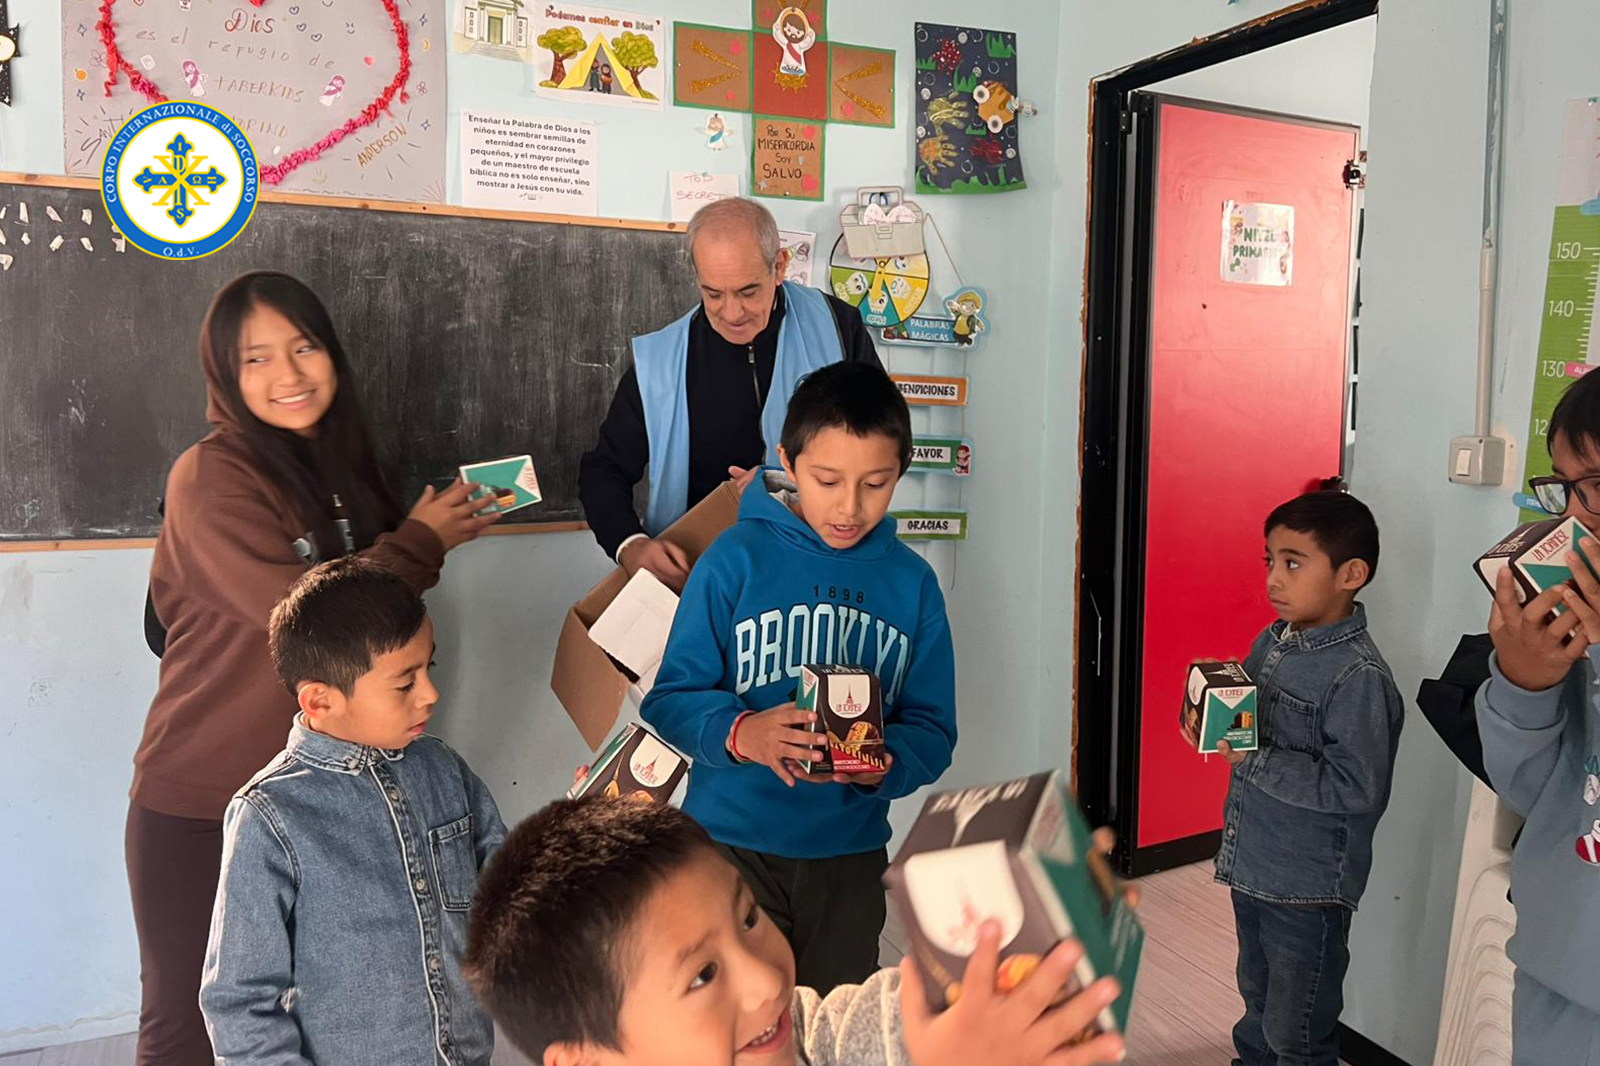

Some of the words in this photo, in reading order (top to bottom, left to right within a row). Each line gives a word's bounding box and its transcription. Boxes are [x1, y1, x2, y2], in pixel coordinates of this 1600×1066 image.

[224, 8, 276, 34] Dios
[136, 30, 156, 41] es
[171, 27, 188, 45] el
[308, 54, 335, 69] de
[468, 114, 501, 125] Enseñar
[503, 118, 510, 126] la
[512, 120, 542, 129] Palabra
[543, 123, 553, 131] de
[555, 124, 572, 133] Dios
[579, 127, 591, 135] los
[473, 127, 496, 135] niños
[509, 130, 542, 140] sembrar
[543, 134, 575, 144] semillas
[577, 137, 587, 145] de
[485, 139, 524, 148] eternidad
[536, 144, 576, 154] corazones
[757, 138, 816, 151] MISERICORDIA
[470, 148, 513, 158] pequeños,
[529, 154, 554, 162] mayor
[555, 155, 590, 166] privilegio
[481, 159, 491, 167] de
[504, 161, 538, 170] maestro
[550, 166, 580, 175] escuela
[762, 163, 802, 179] SALVO
[476, 180, 508, 188] mostrar
[521, 172, 539, 181] solo
[540, 174, 573, 185] enseñar,
[574, 178, 590, 186] sino
[1556, 242, 1581, 259] 150
[1548, 299, 1574, 317] 140
[910, 318, 950, 330] PALABRAS
[1542, 360, 1565, 378] 130
[912, 447, 944, 459] FAVOR
[907, 520, 949, 530] GRACIAS
[813, 584, 864, 604] 1898
[735, 603, 909, 706] BROOKLYN
